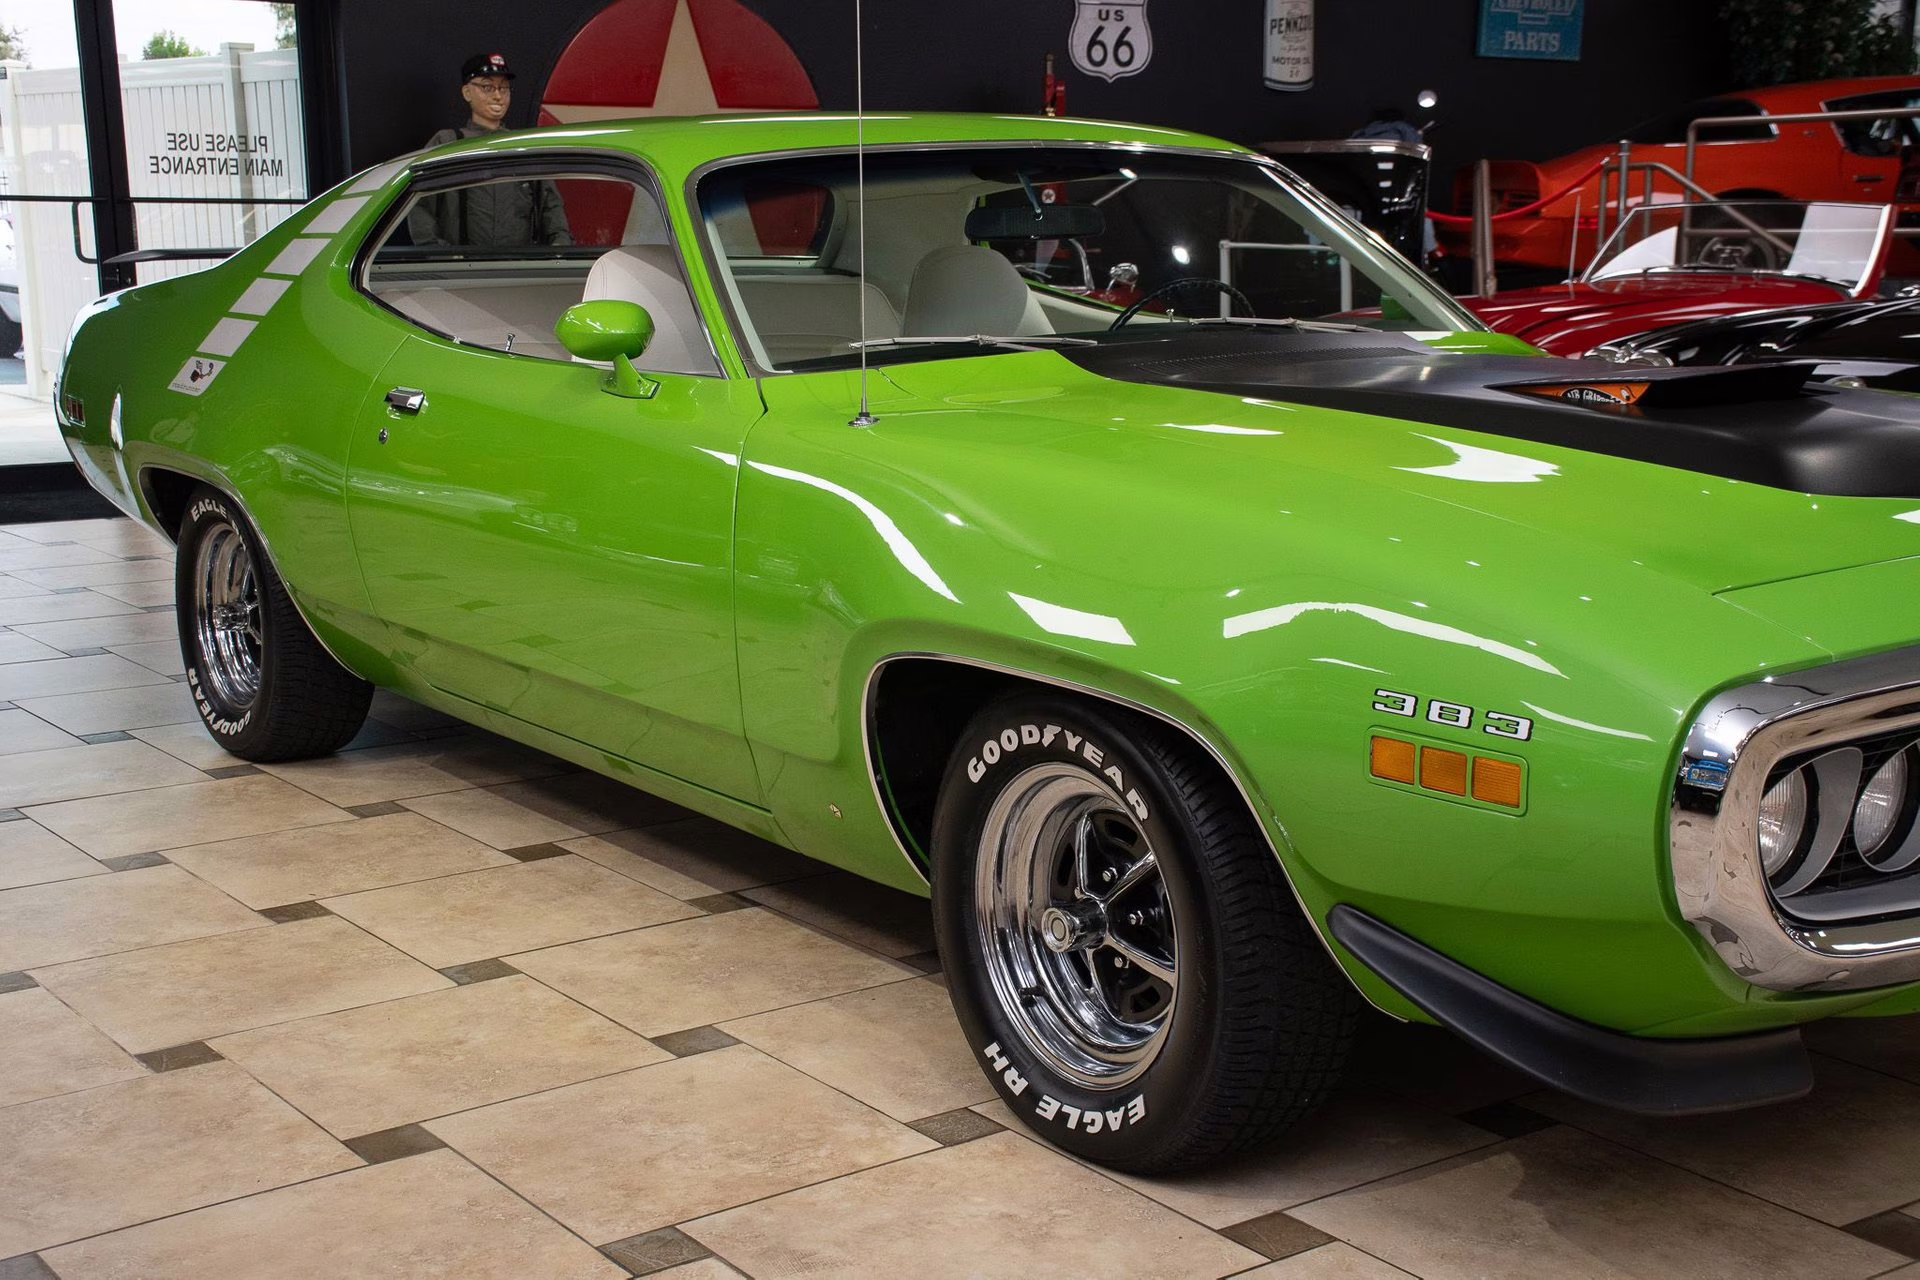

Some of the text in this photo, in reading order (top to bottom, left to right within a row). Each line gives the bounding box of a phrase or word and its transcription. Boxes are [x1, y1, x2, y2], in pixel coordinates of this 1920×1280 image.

[1098, 9, 1125, 22] US
[1086, 25, 1135, 68] 66
[1272, 56, 1301, 66] MOTOR
[1502, 30, 1560, 52] PARTS
[191, 498, 228, 522] EAGLE
[187, 667, 251, 736] GOODYEAR
[1372, 688, 1534, 742] 383
[967, 723, 1150, 823] GOODYEAR
[983, 1042, 1147, 1135] EAGLE RH
